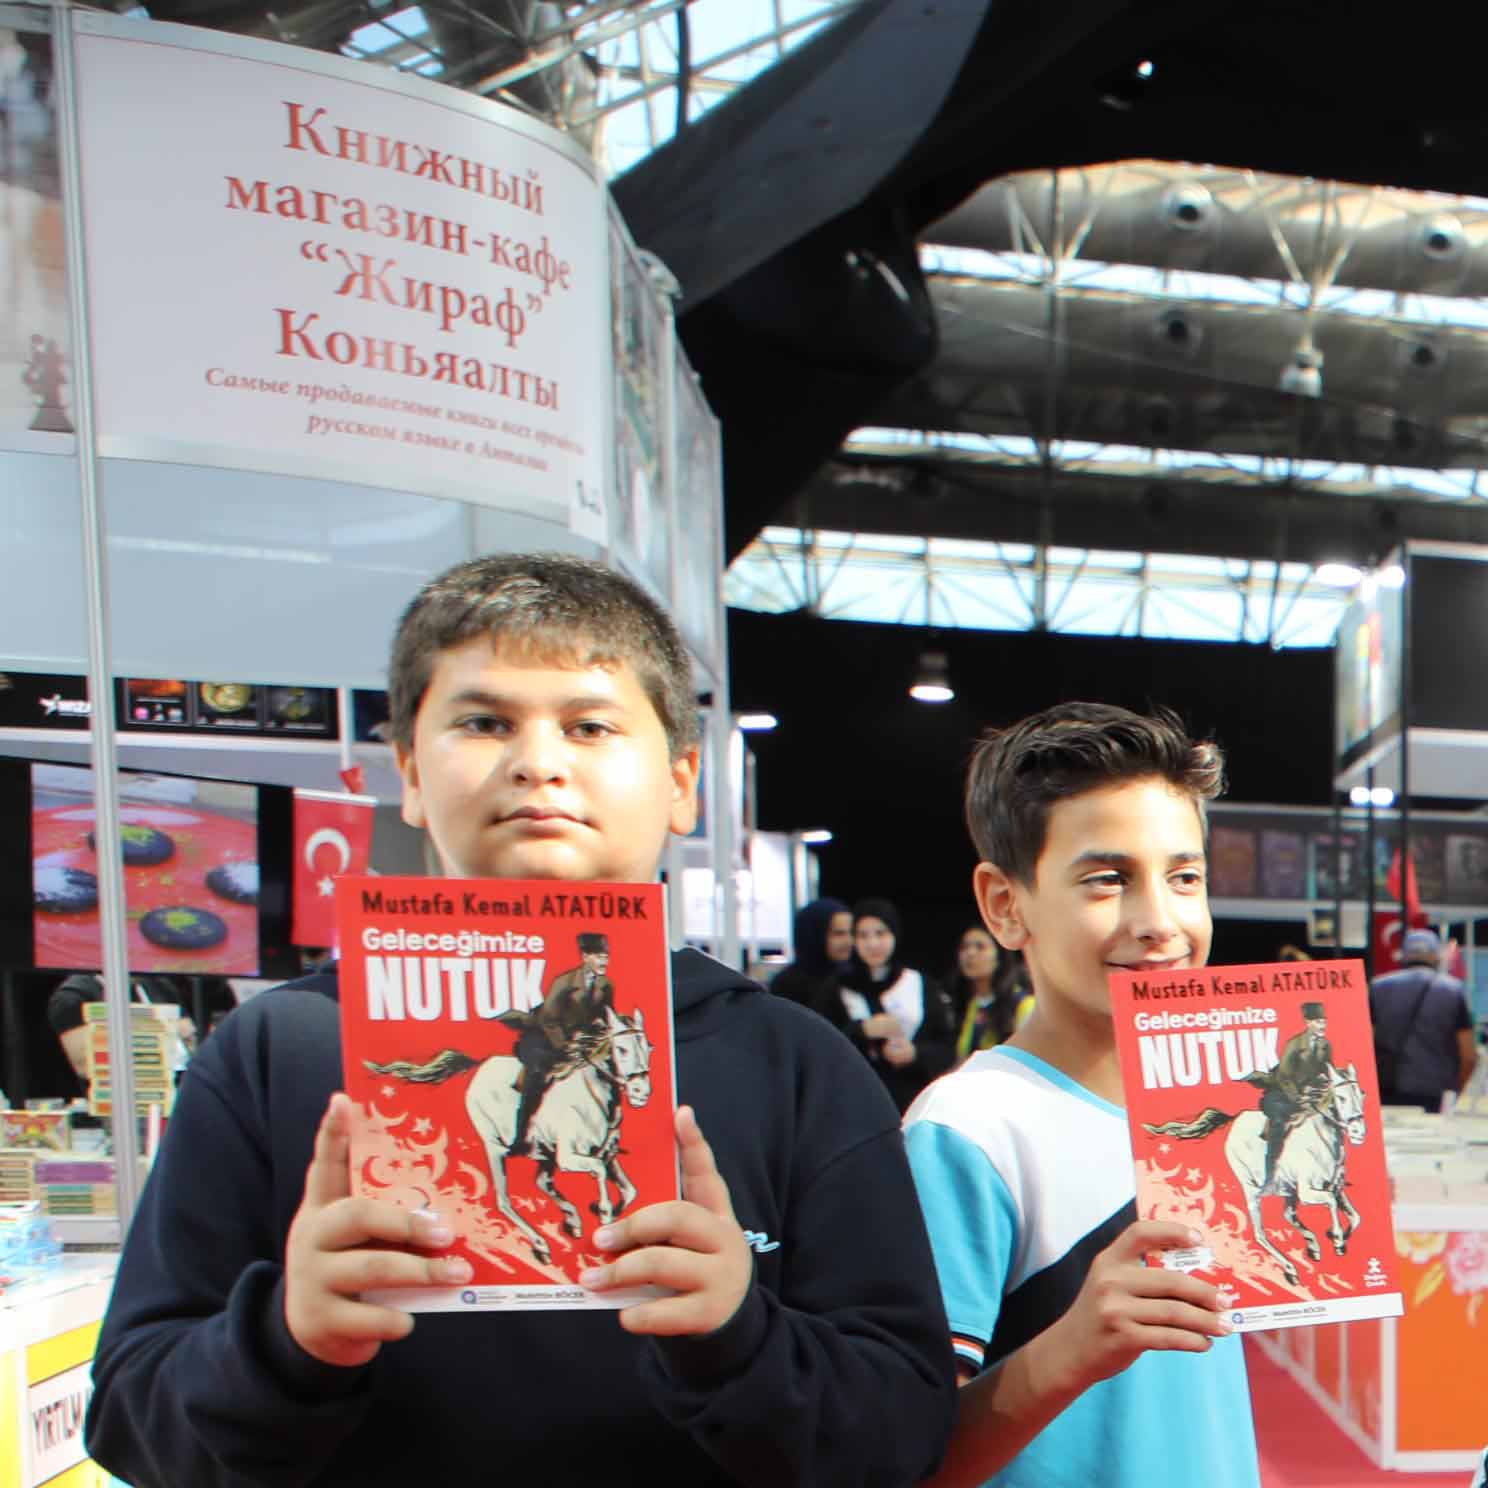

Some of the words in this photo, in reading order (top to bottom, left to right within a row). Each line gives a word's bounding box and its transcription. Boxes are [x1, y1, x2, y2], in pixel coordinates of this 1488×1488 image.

[281, 101, 544, 216] Книжный
[224, 176, 571, 296] магазин-кафе
[273, 308, 559, 410] Коньяалты
[205, 367, 290, 394] Самые
[306, 414, 396, 442] русском
[361, 890, 454, 916] Mustafa
[462, 892, 532, 917] Kemal
[540, 891, 648, 920] ATATÜRK
[361, 927, 545, 956] Geleceğimize
[365, 956, 546, 1021] NUTUK
[1132, 978, 1206, 1001] Mustafa
[1211, 975, 1265, 996] Kemal
[1271, 968, 1352, 992] ATATÜRK
[1134, 1007, 1277, 1031] Geleceğimize
[1137, 1027, 1280, 1089] NUTUK
